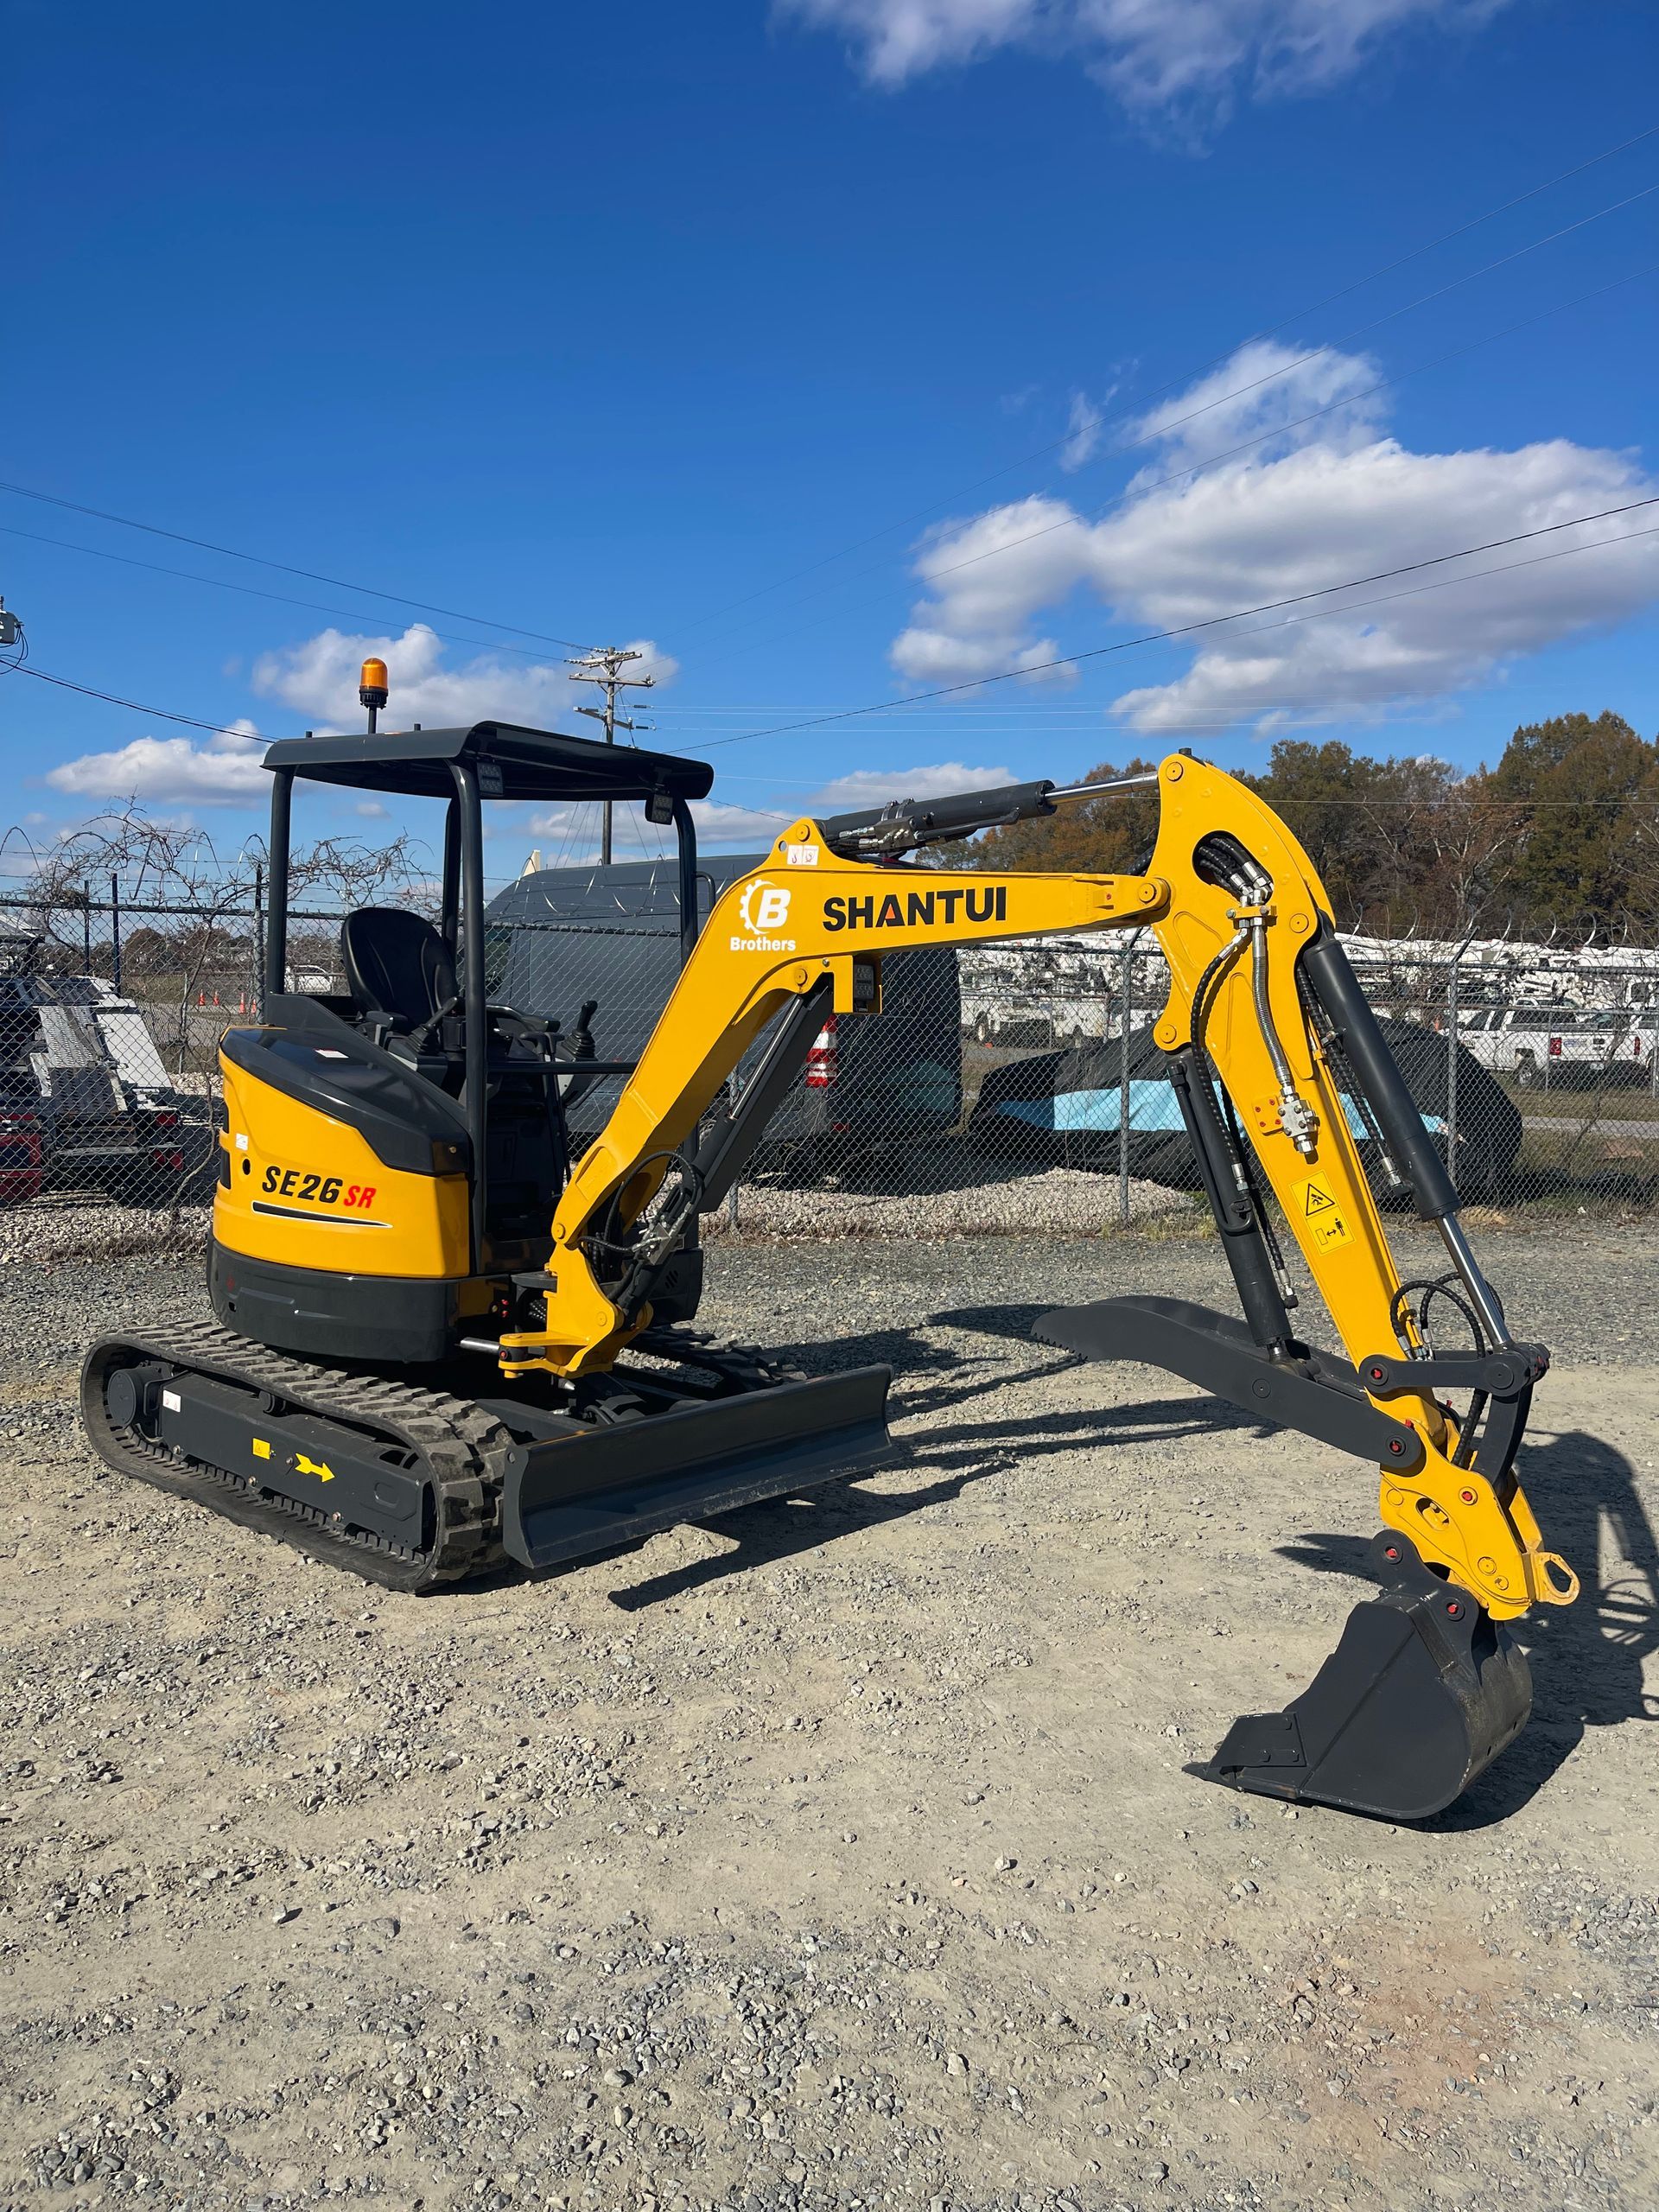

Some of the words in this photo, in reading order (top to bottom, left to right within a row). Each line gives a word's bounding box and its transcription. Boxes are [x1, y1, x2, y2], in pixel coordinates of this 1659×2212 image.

[756, 889, 791, 928] B
[823, 886, 1007, 931] SHANTUI
[730, 937, 797, 951] Brothers
[262, 1166, 343, 1204] SE26
[343, 1185, 377, 1209] SR
